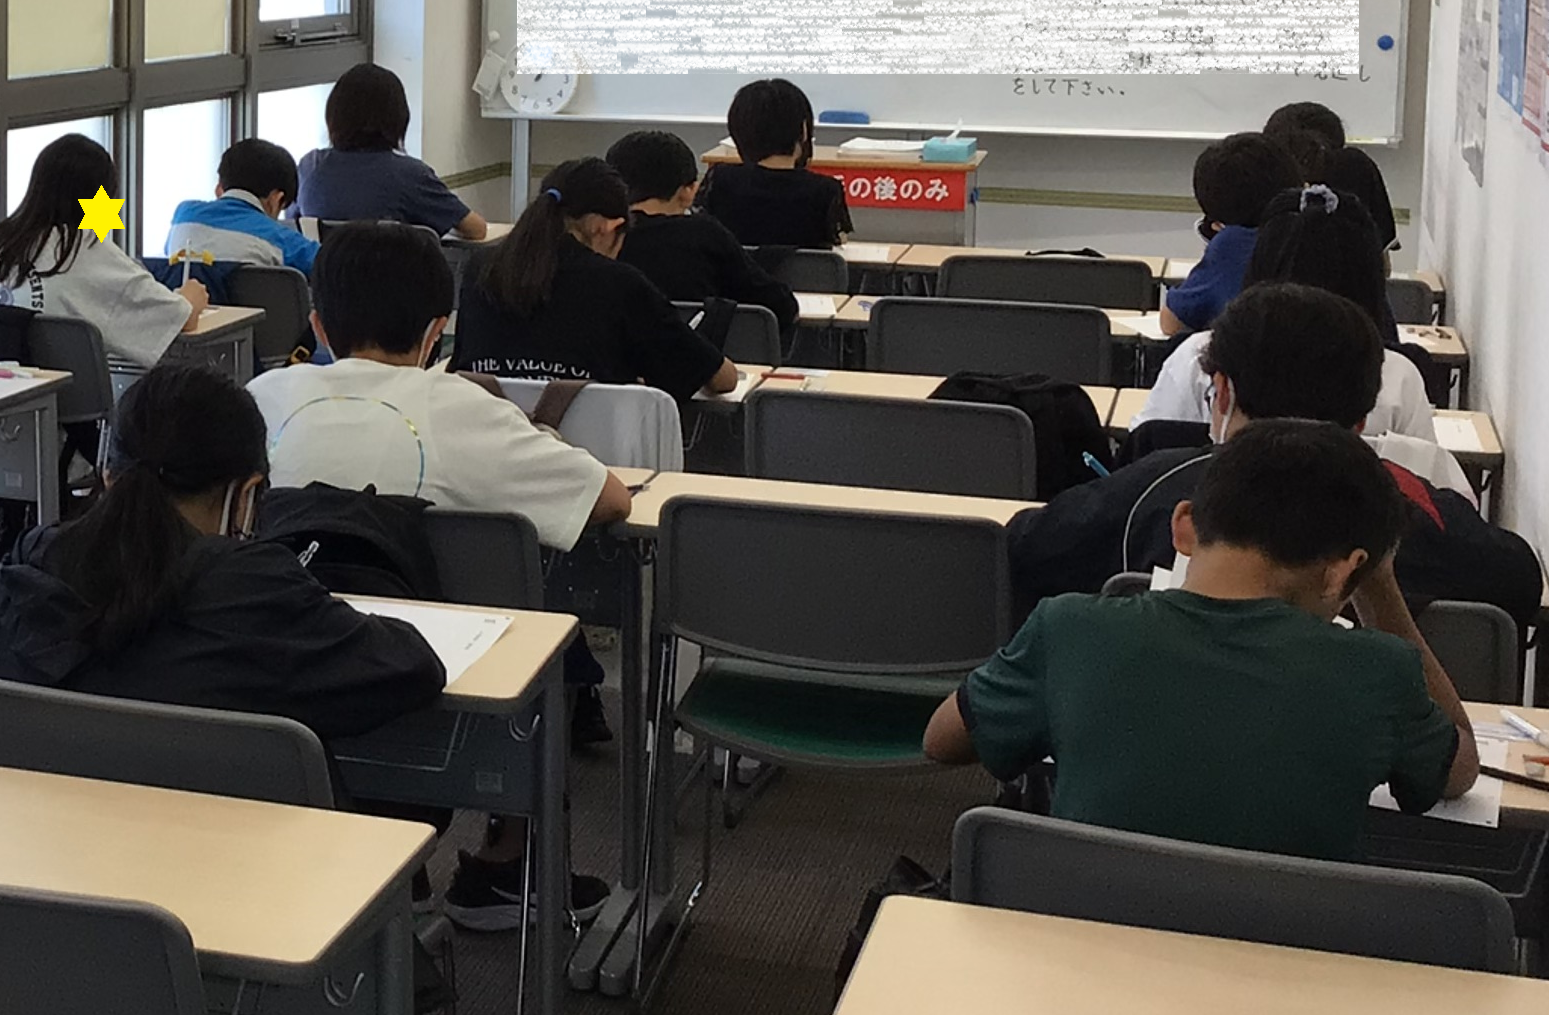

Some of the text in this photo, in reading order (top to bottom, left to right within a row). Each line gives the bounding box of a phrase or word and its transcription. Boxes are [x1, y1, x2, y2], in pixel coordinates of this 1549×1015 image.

[1013, 76, 1126, 97] をして下さい。
[506, 358, 567, 374] VALUE
[570, 365, 591, 379] O
